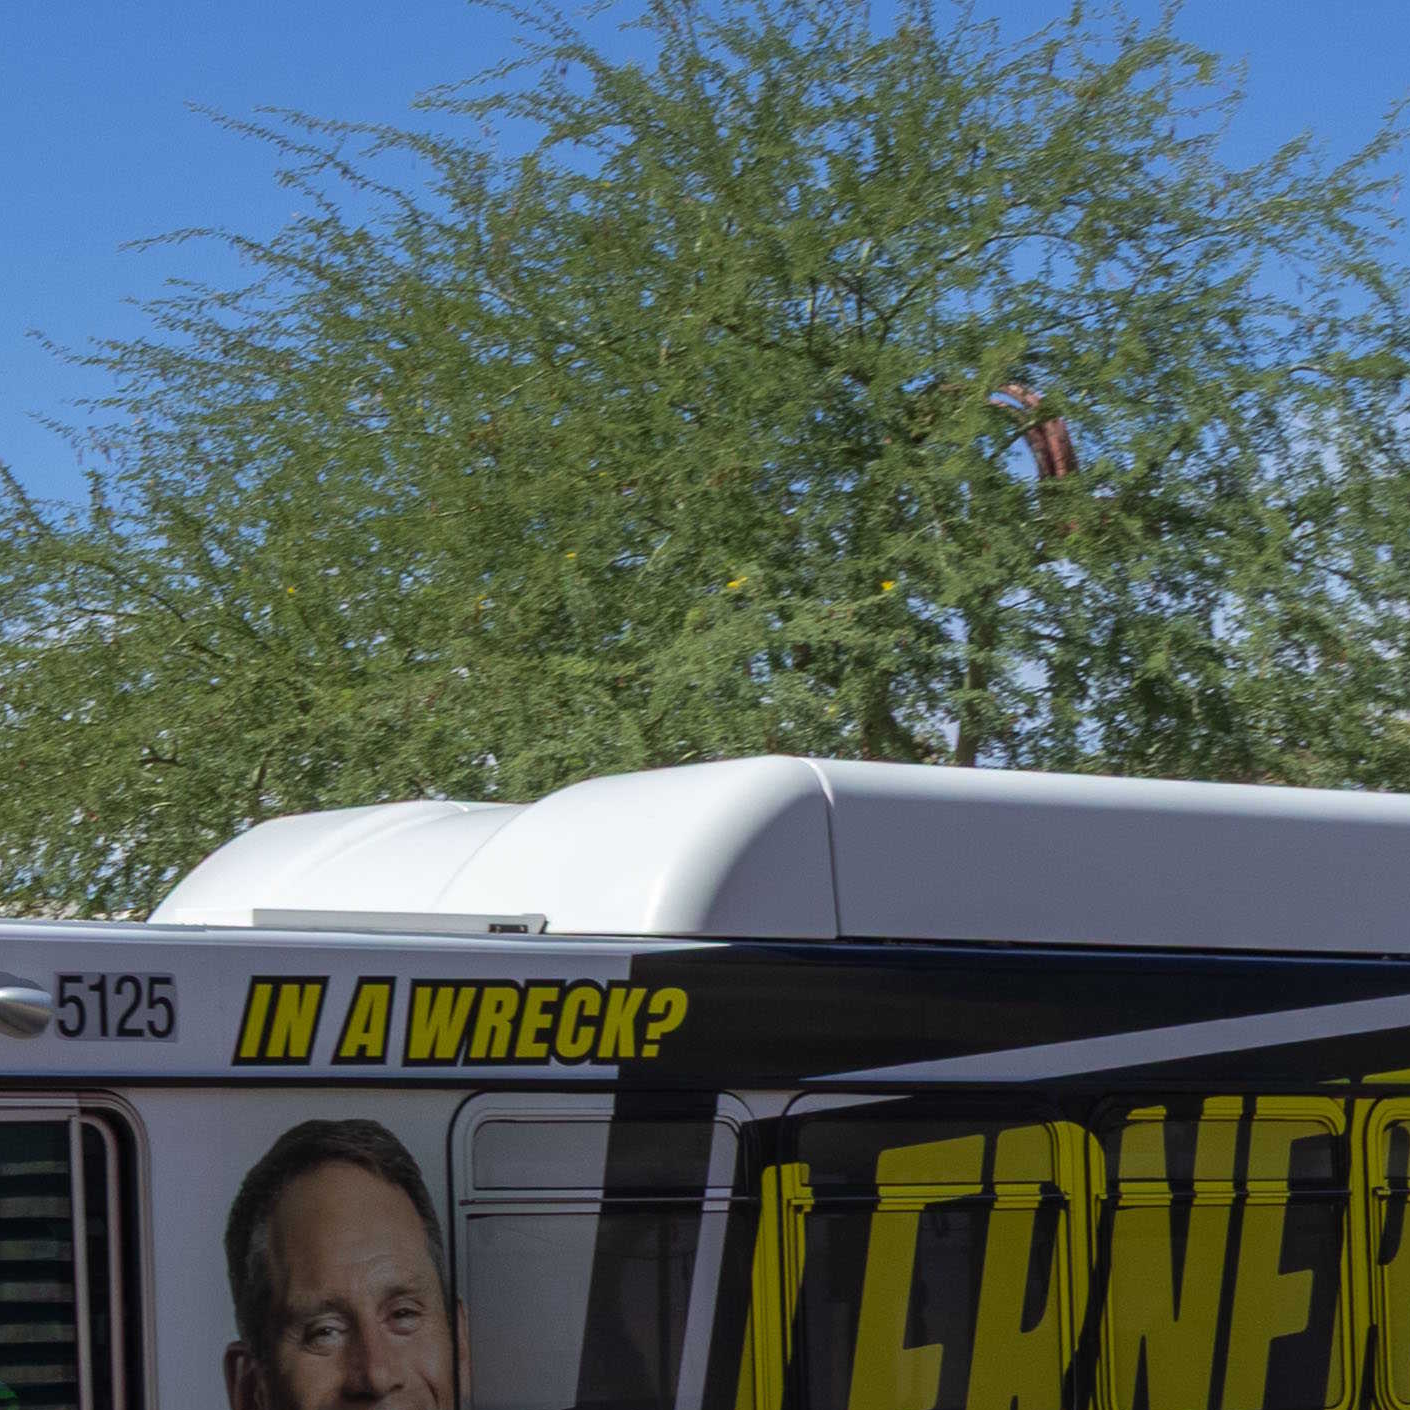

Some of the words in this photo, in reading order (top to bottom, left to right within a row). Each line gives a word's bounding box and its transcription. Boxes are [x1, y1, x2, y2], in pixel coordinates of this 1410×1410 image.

[55, 974, 176, 1038] 5125
[237, 983, 323, 1059] IN
[337, 984, 391, 1059] A
[406, 985, 689, 1060] WRECK?
